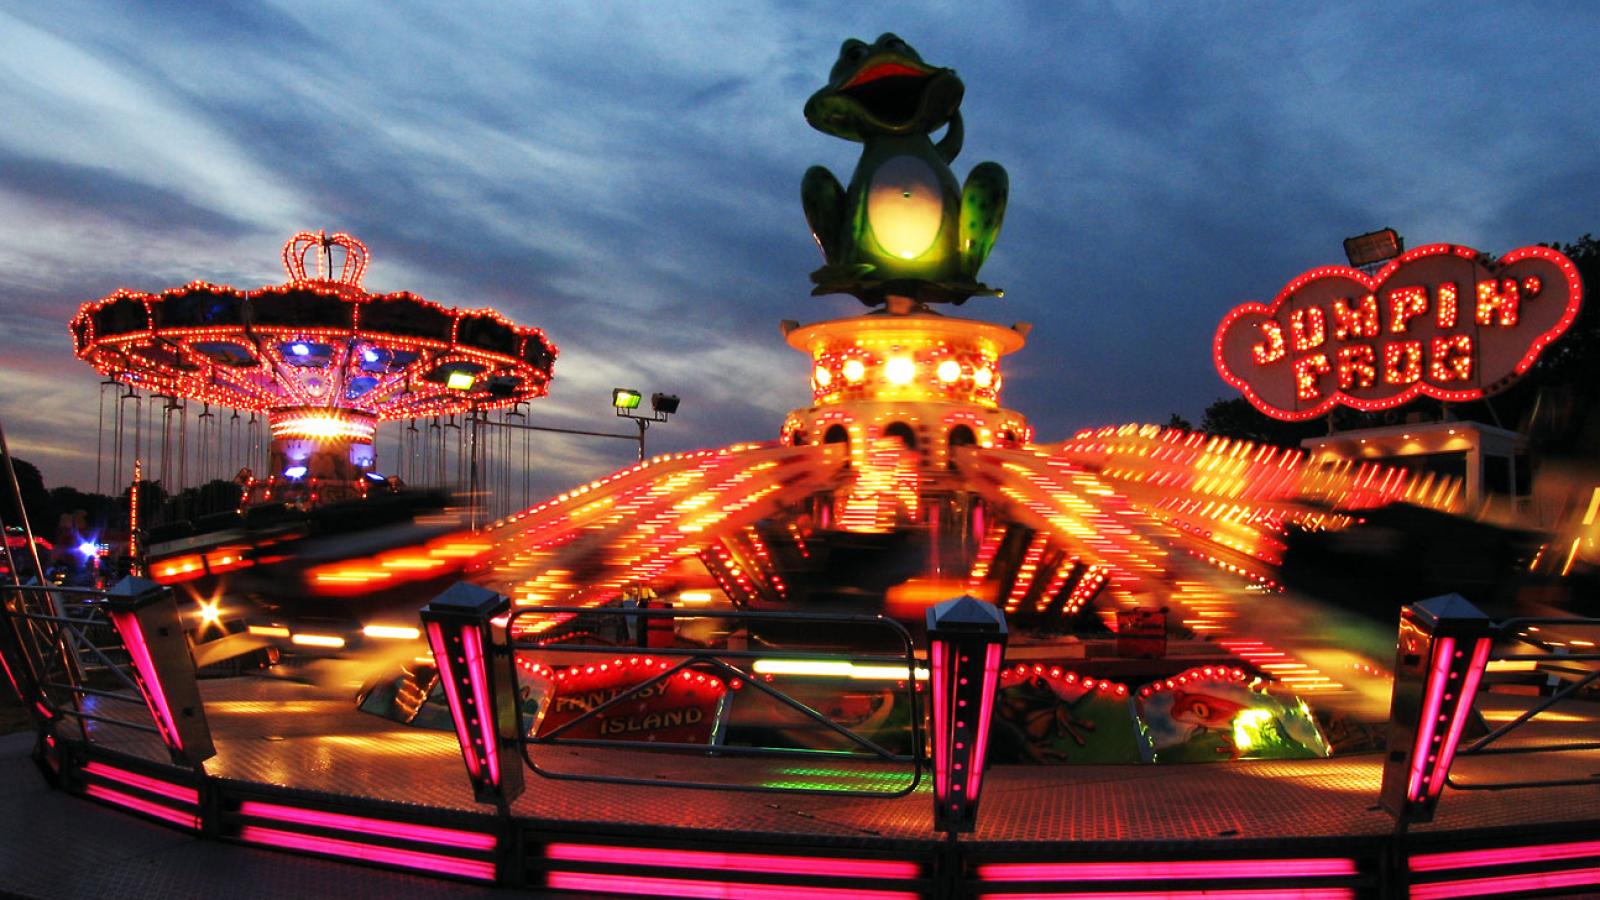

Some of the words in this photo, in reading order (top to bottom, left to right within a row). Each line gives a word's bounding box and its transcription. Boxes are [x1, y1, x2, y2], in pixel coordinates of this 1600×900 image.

[1252, 275, 1542, 364] JUMPIN'
[1291, 335, 1472, 401] FROG
[555, 681, 671, 713] FANTSY
[600, 706, 703, 735] ISLAND
